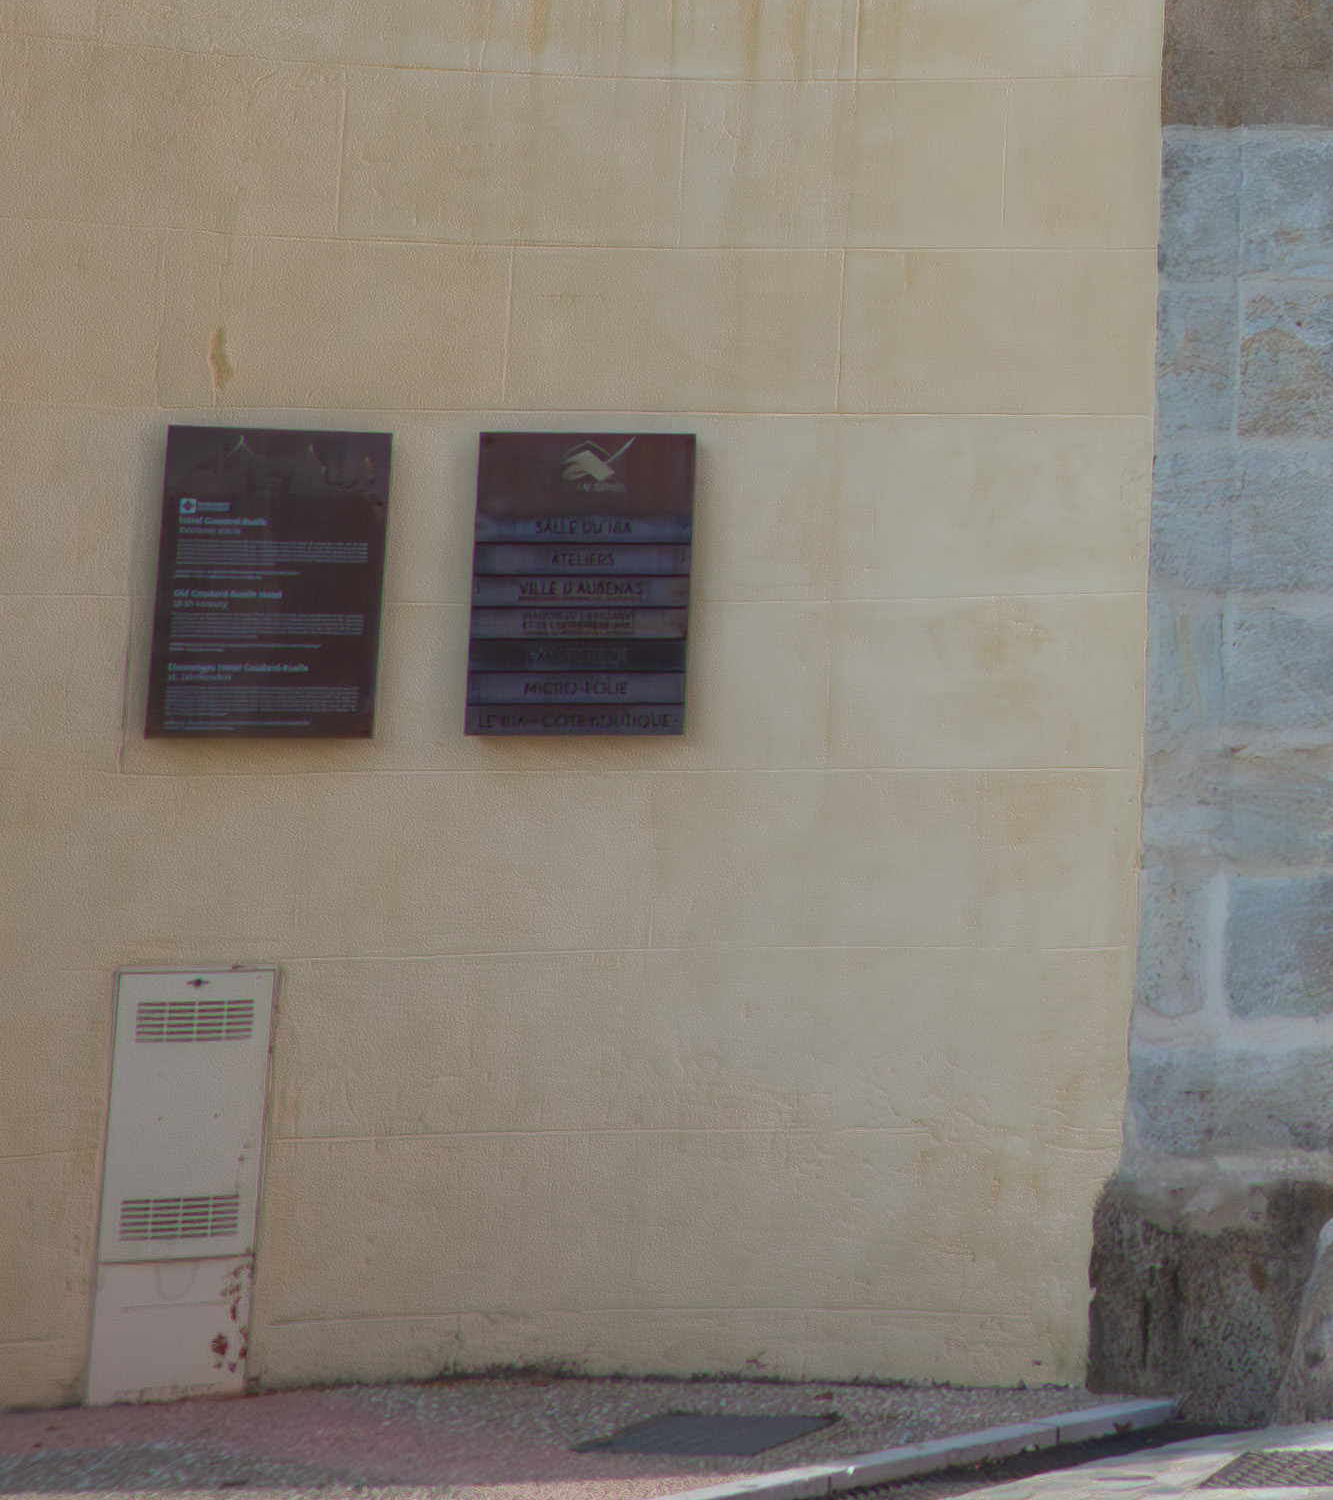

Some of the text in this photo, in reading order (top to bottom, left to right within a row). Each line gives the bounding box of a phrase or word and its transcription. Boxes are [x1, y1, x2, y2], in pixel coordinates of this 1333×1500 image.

[535, 520, 579, 534] SALLE
[582, 520, 604, 534] DU
[551, 552, 615, 566] ATELIERS
[519, 580, 558, 596] VILLE
